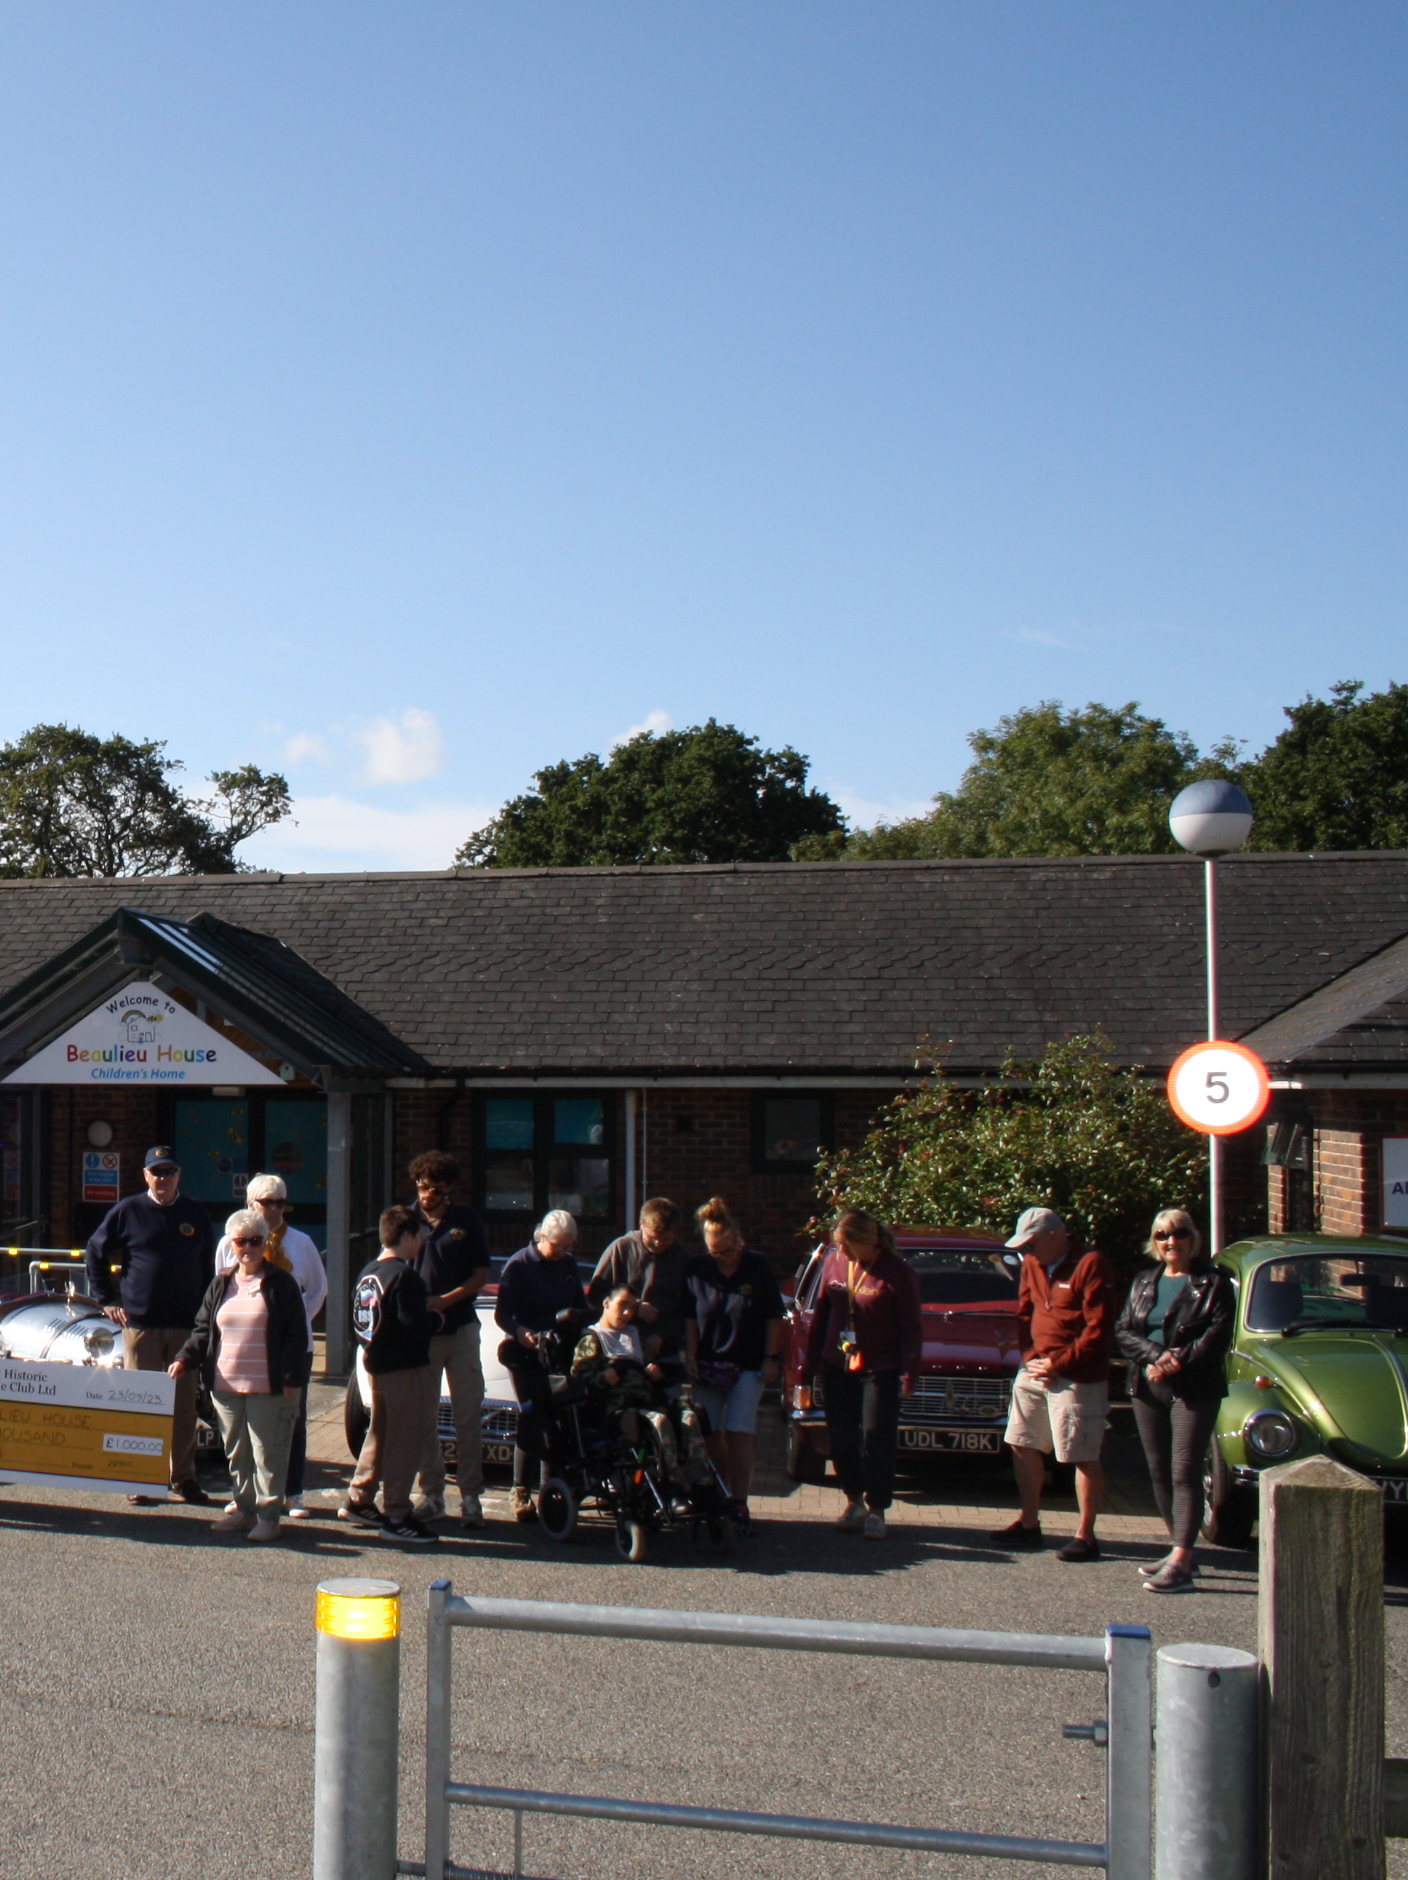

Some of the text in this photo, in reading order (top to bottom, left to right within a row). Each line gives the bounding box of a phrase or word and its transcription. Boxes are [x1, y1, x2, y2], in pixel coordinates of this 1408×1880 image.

[105, 995, 176, 1014] Welcome to
[66, 1044, 217, 1063] Beaulieu House
[91, 1068, 186, 1080] Children's Home
[1205, 1071, 1230, 1104] 5
[4, 1368, 48, 1382] Historic
[9, 1381, 35, 1394] Club
[38, 1384, 57, 1396] Ltd
[85, 1391, 104, 1400] Date
[42, 1413, 92, 1429] HOUSE
[904, 1430, 992, 1450] UDL 718K
